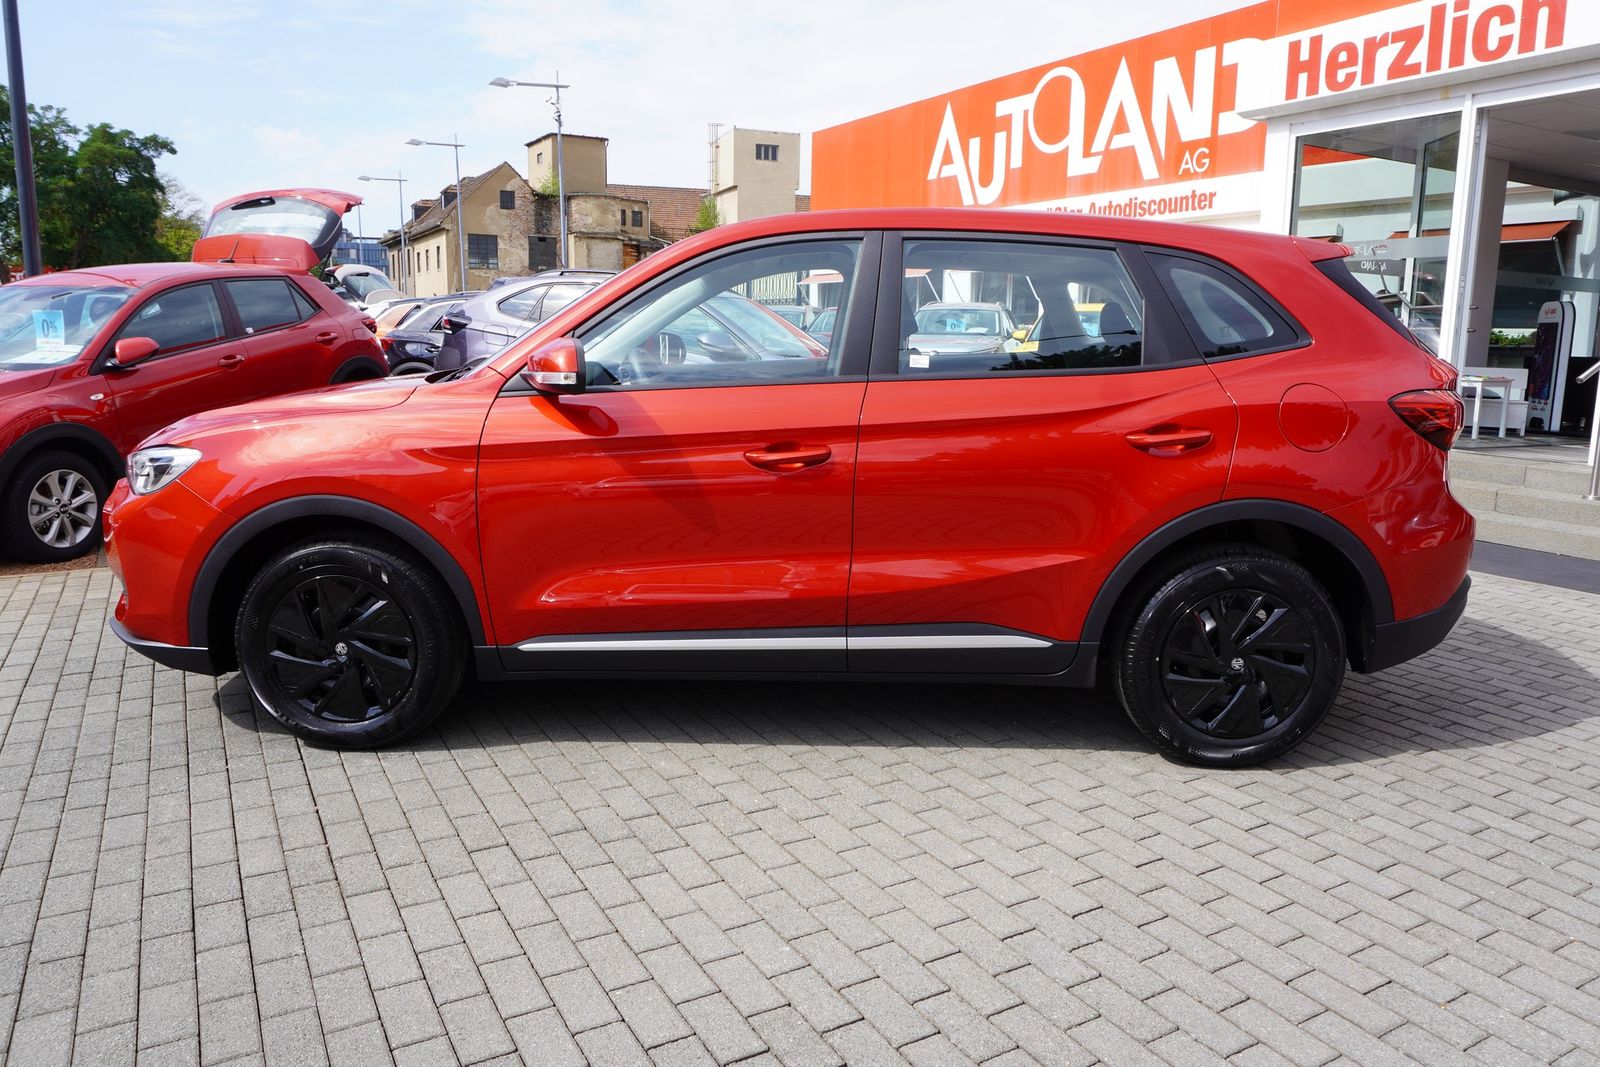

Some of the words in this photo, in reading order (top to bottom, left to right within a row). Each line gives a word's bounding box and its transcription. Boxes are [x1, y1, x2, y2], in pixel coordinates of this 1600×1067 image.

[1285, 0, 1567, 101] Herzlich
[1178, 147, 1210, 175] AG
[1088, 190, 1217, 217] Autodiscounter
[41, 319, 58, 337] 0%
